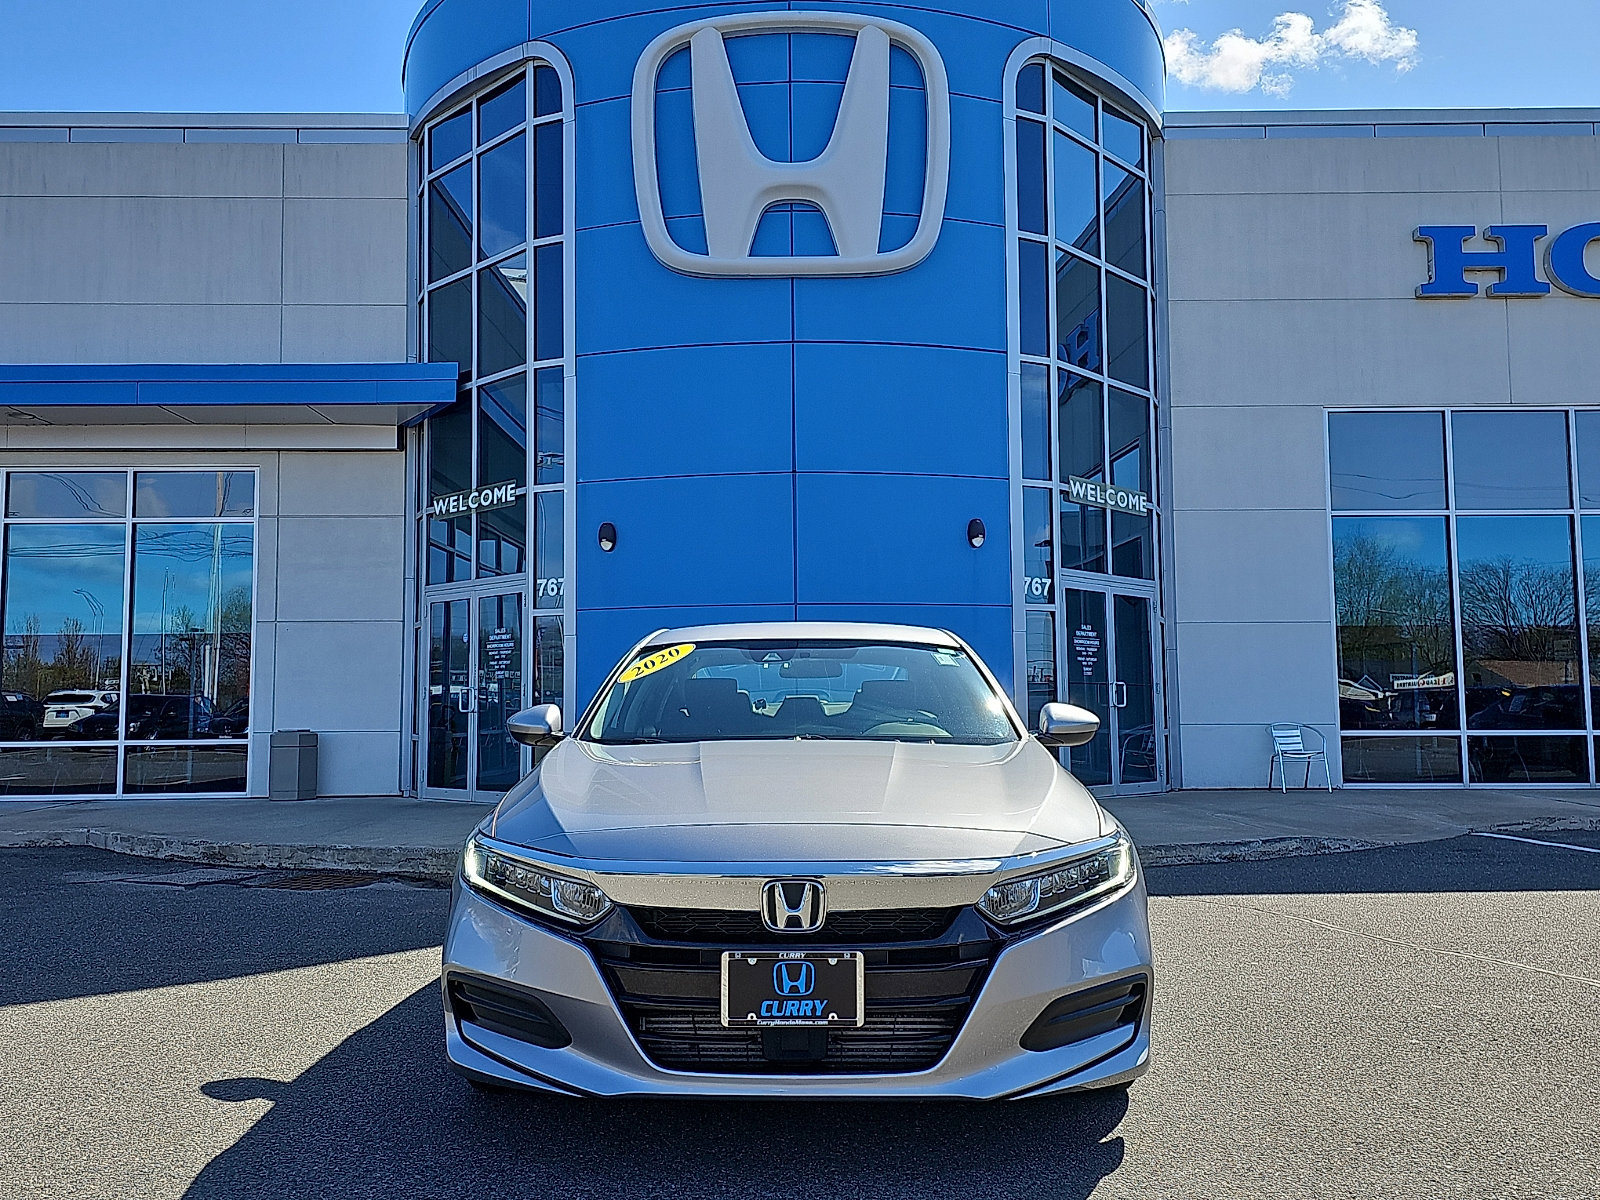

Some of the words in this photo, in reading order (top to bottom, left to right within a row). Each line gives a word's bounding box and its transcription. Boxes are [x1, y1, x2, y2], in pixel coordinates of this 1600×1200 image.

[433, 483, 516, 515] WELCOME
[1069, 480, 1147, 512] WELCOME
[536, 578, 564, 597] 767
[1024, 576, 1052, 596] 767
[630, 647, 681, 677] 2020
[760, 1000, 829, 1017] CURRY
